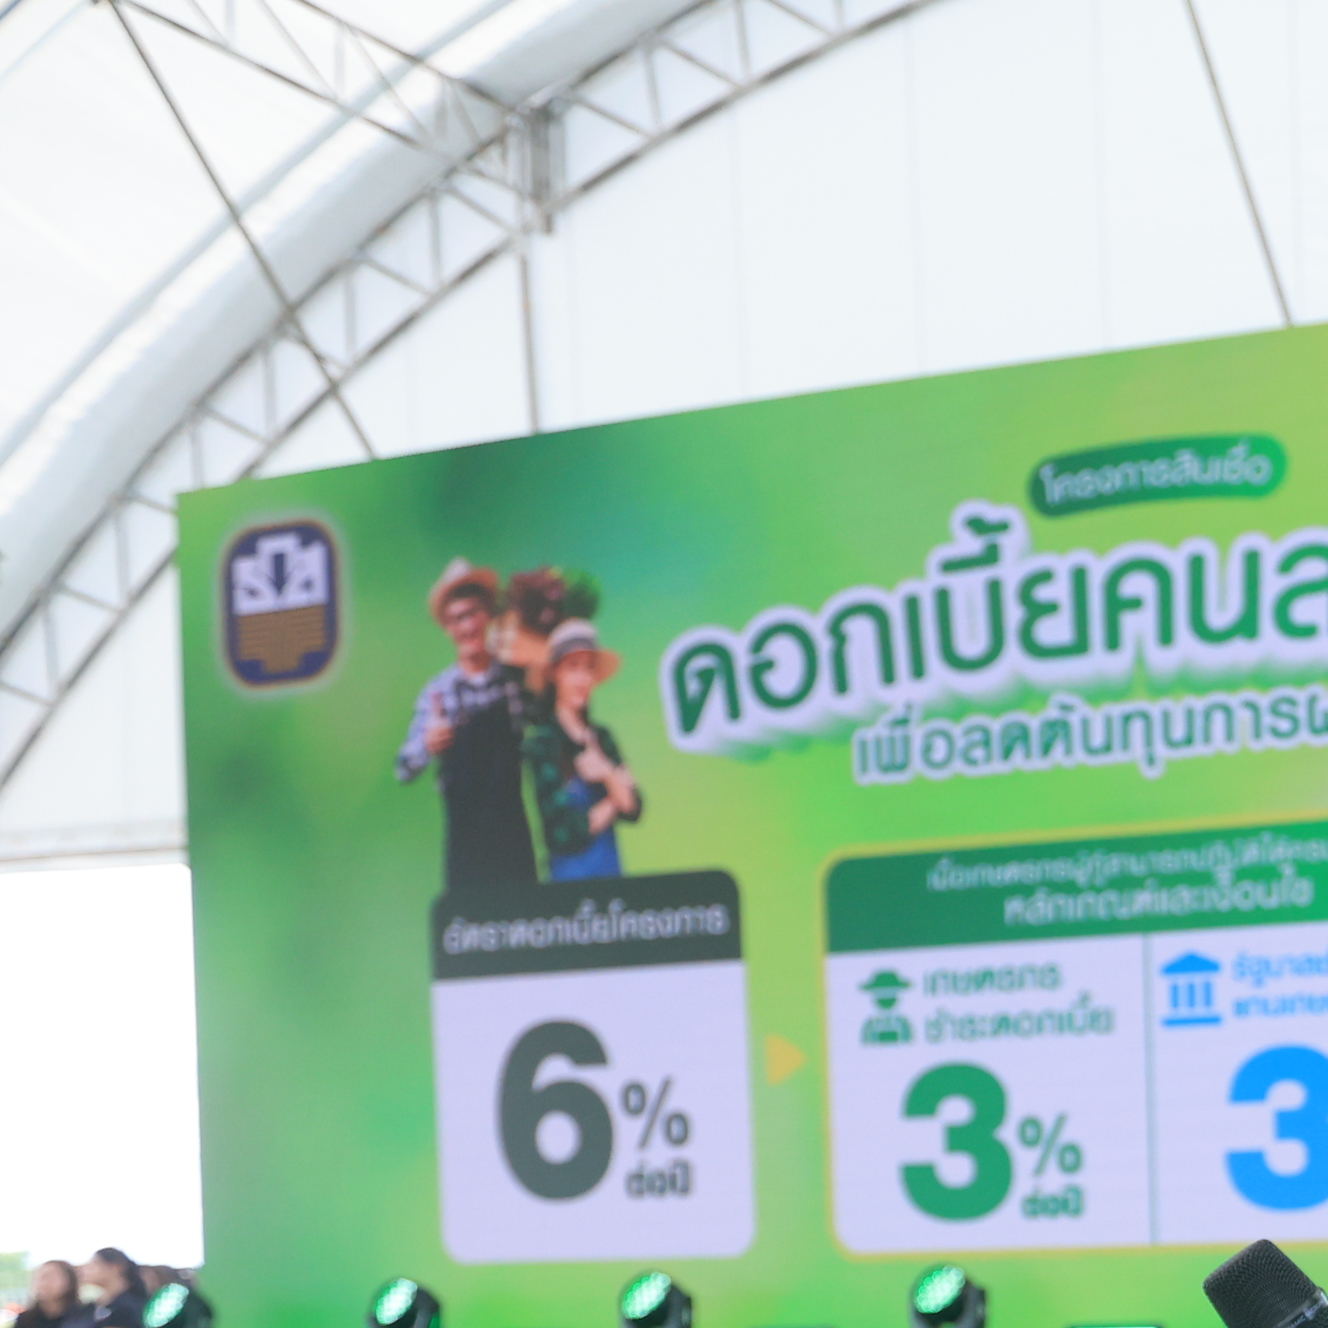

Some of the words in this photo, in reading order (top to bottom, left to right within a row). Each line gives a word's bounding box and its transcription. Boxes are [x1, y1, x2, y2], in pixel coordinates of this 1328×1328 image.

[1039, 437, 1274, 507] โครงการสินเชื่อ
[443, 897, 731, 955] อัตราดอกเบี้ยโครงการ
[923, 961, 1063, 998] เกษตรกร
[924, 992, 1115, 1044] ชำระดอกเบี้ย
[625, 1159, 693, 1200] ต่อปี
[1022, 1183, 1086, 1220] ต่อปี
